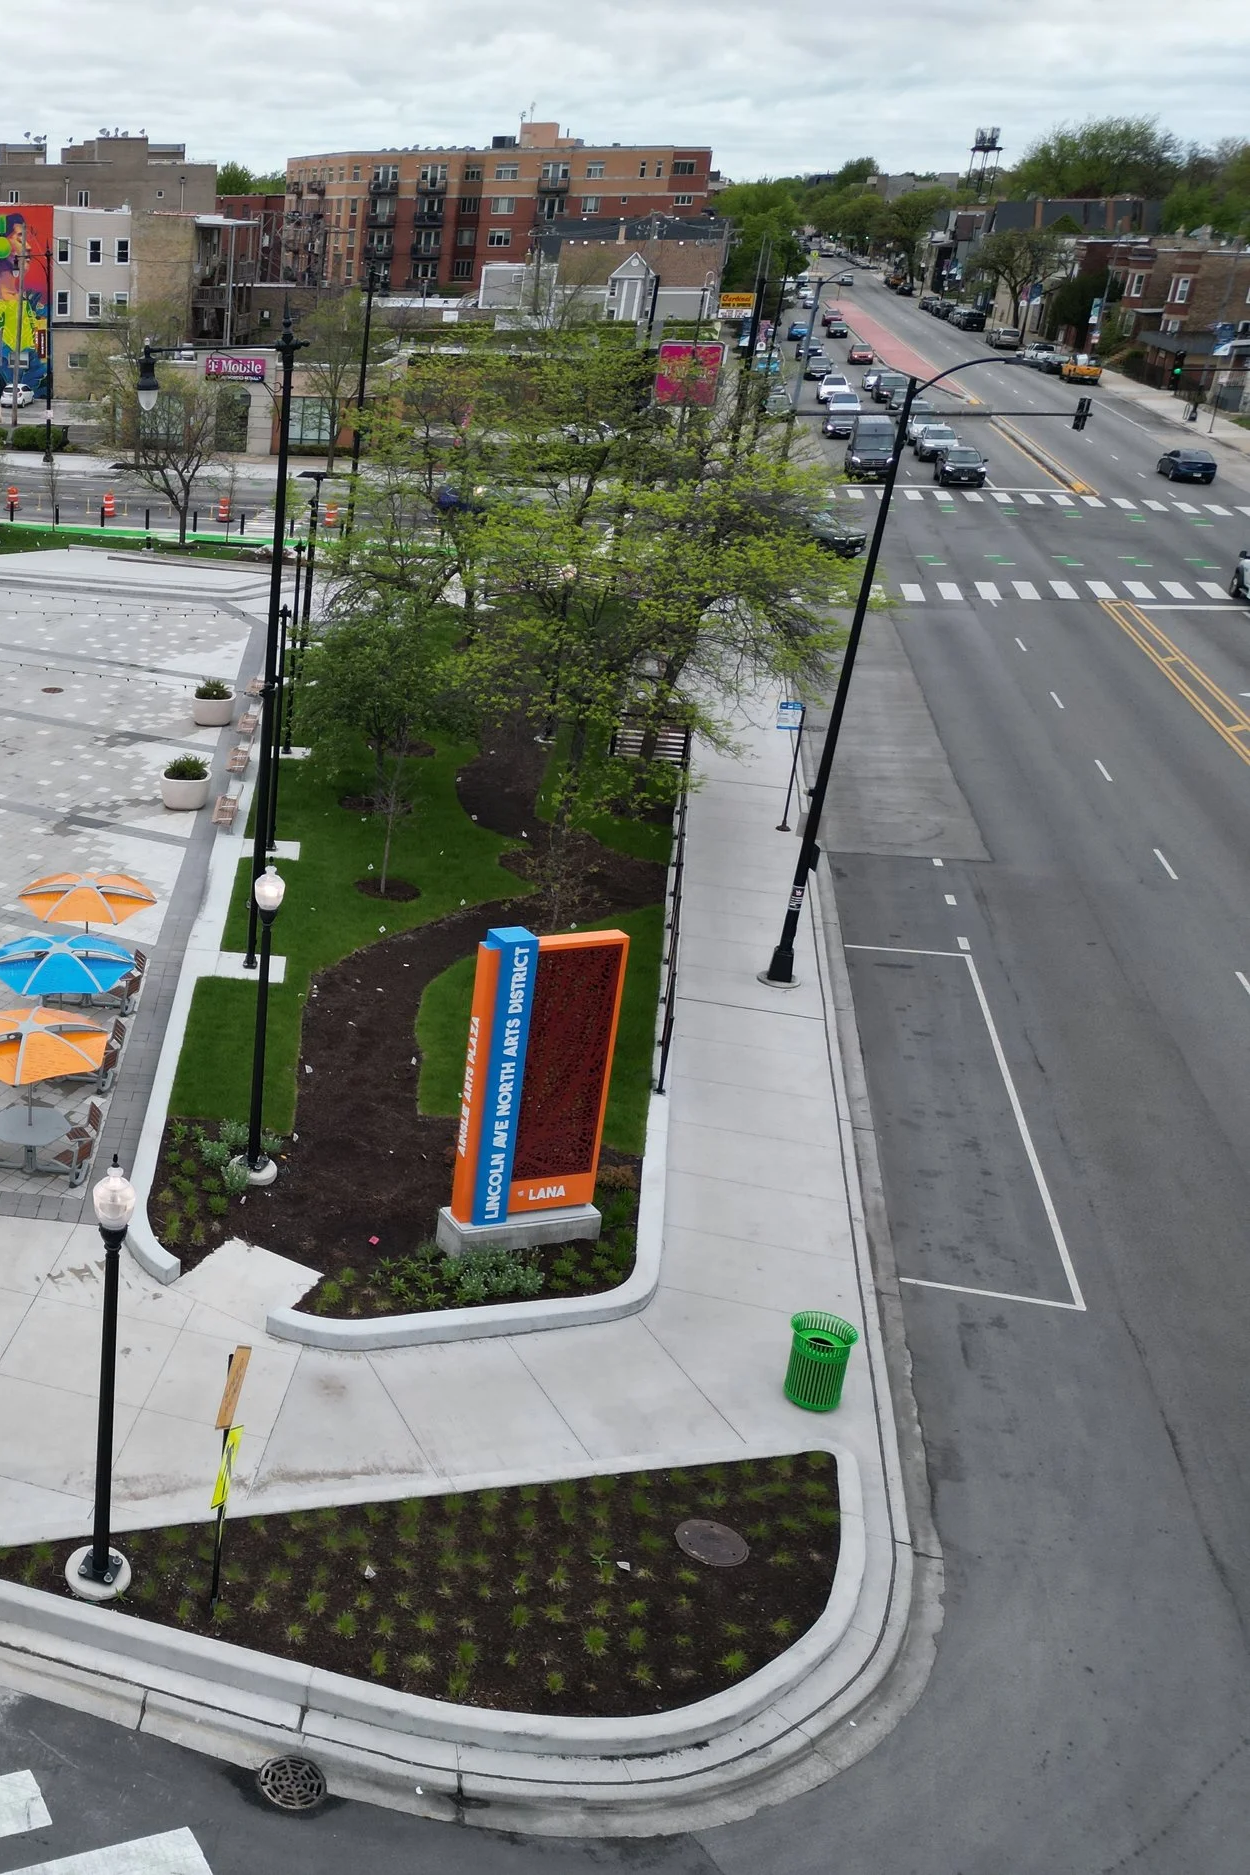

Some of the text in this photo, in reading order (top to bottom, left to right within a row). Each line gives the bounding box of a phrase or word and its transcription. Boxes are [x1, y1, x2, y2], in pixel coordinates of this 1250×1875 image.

[467, 1016, 480, 1064] PLAZA
[463, 1066, 475, 1103] ARTS
[484, 946, 530, 1219] LINCOLN AVE NORTH ARTS DISTRICT
[528, 1185, 566, 1201] LANA
